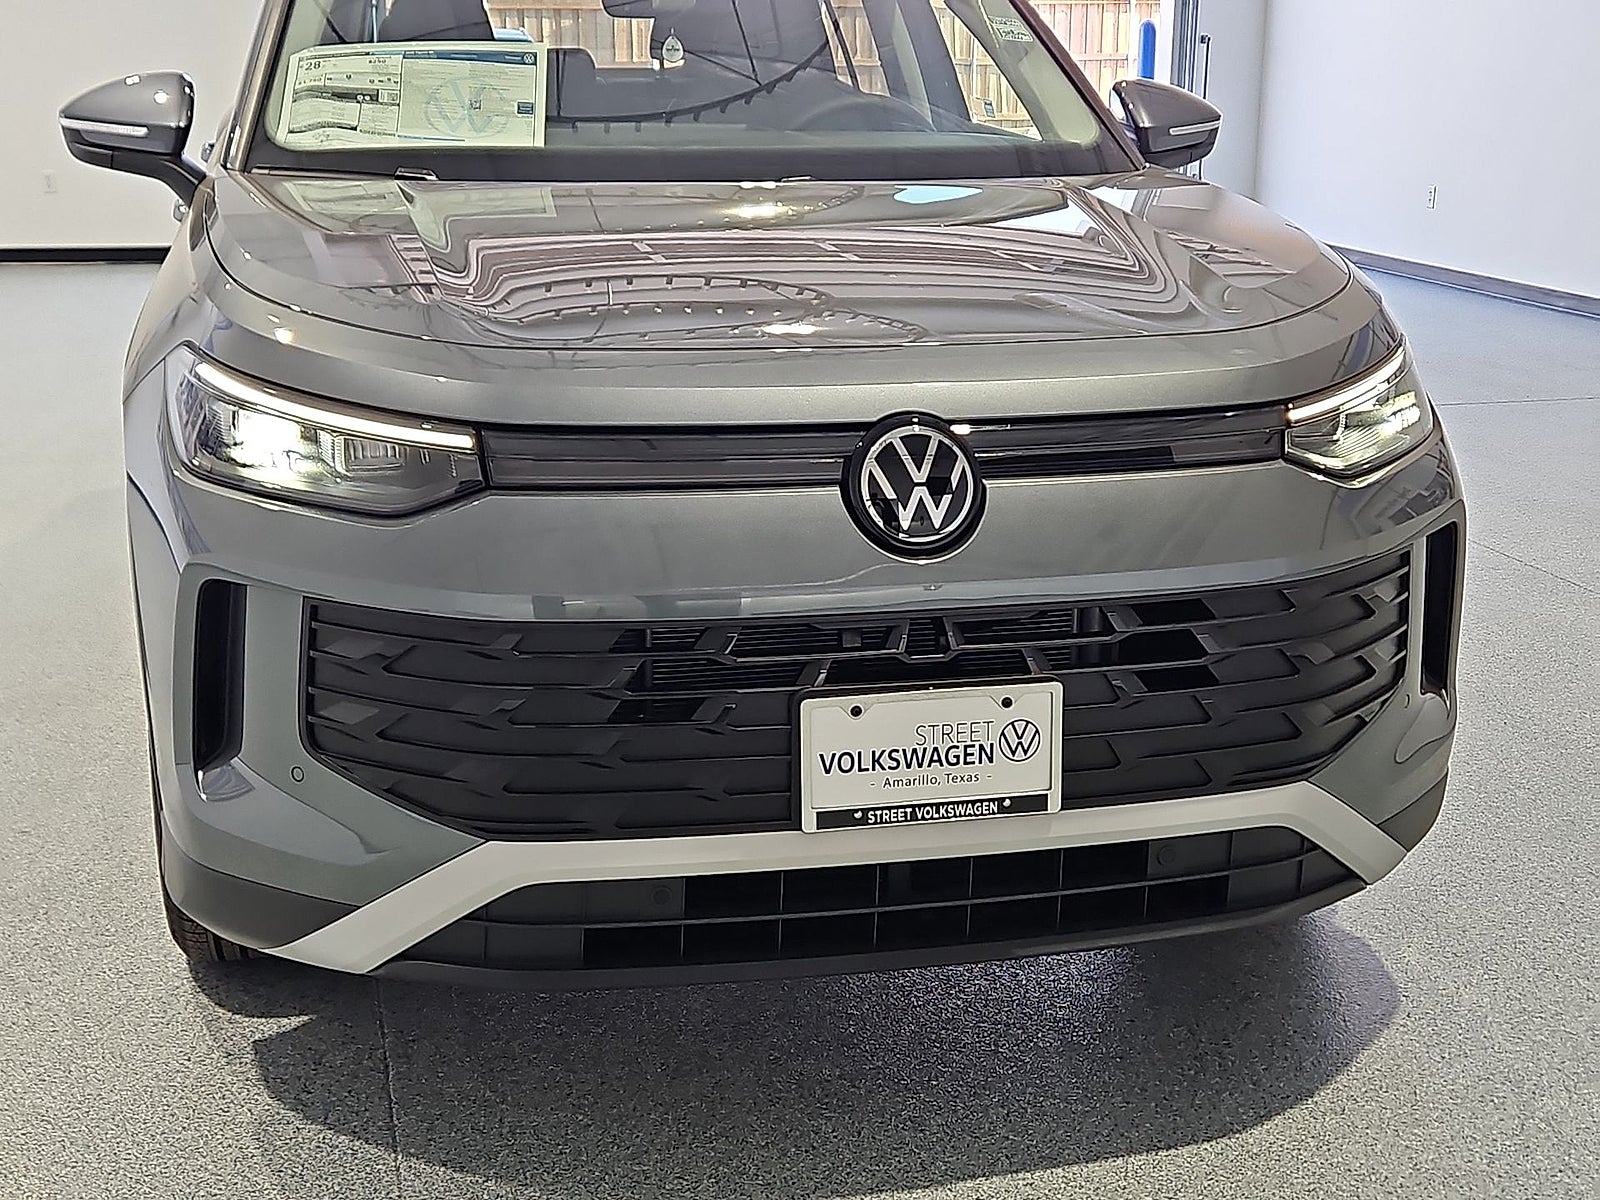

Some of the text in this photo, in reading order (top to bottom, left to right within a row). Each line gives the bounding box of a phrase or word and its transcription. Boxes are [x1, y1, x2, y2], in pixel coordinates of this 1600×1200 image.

[304, 61, 321, 71] 28
[915, 720, 995, 746] STREET
[818, 742, 995, 775] VOLKSWAGEN
[882, 773, 942, 789] Amarillo,
[944, 771, 980, 785] Texas
[867, 801, 998, 824] STREET VOLKSWAGEN
